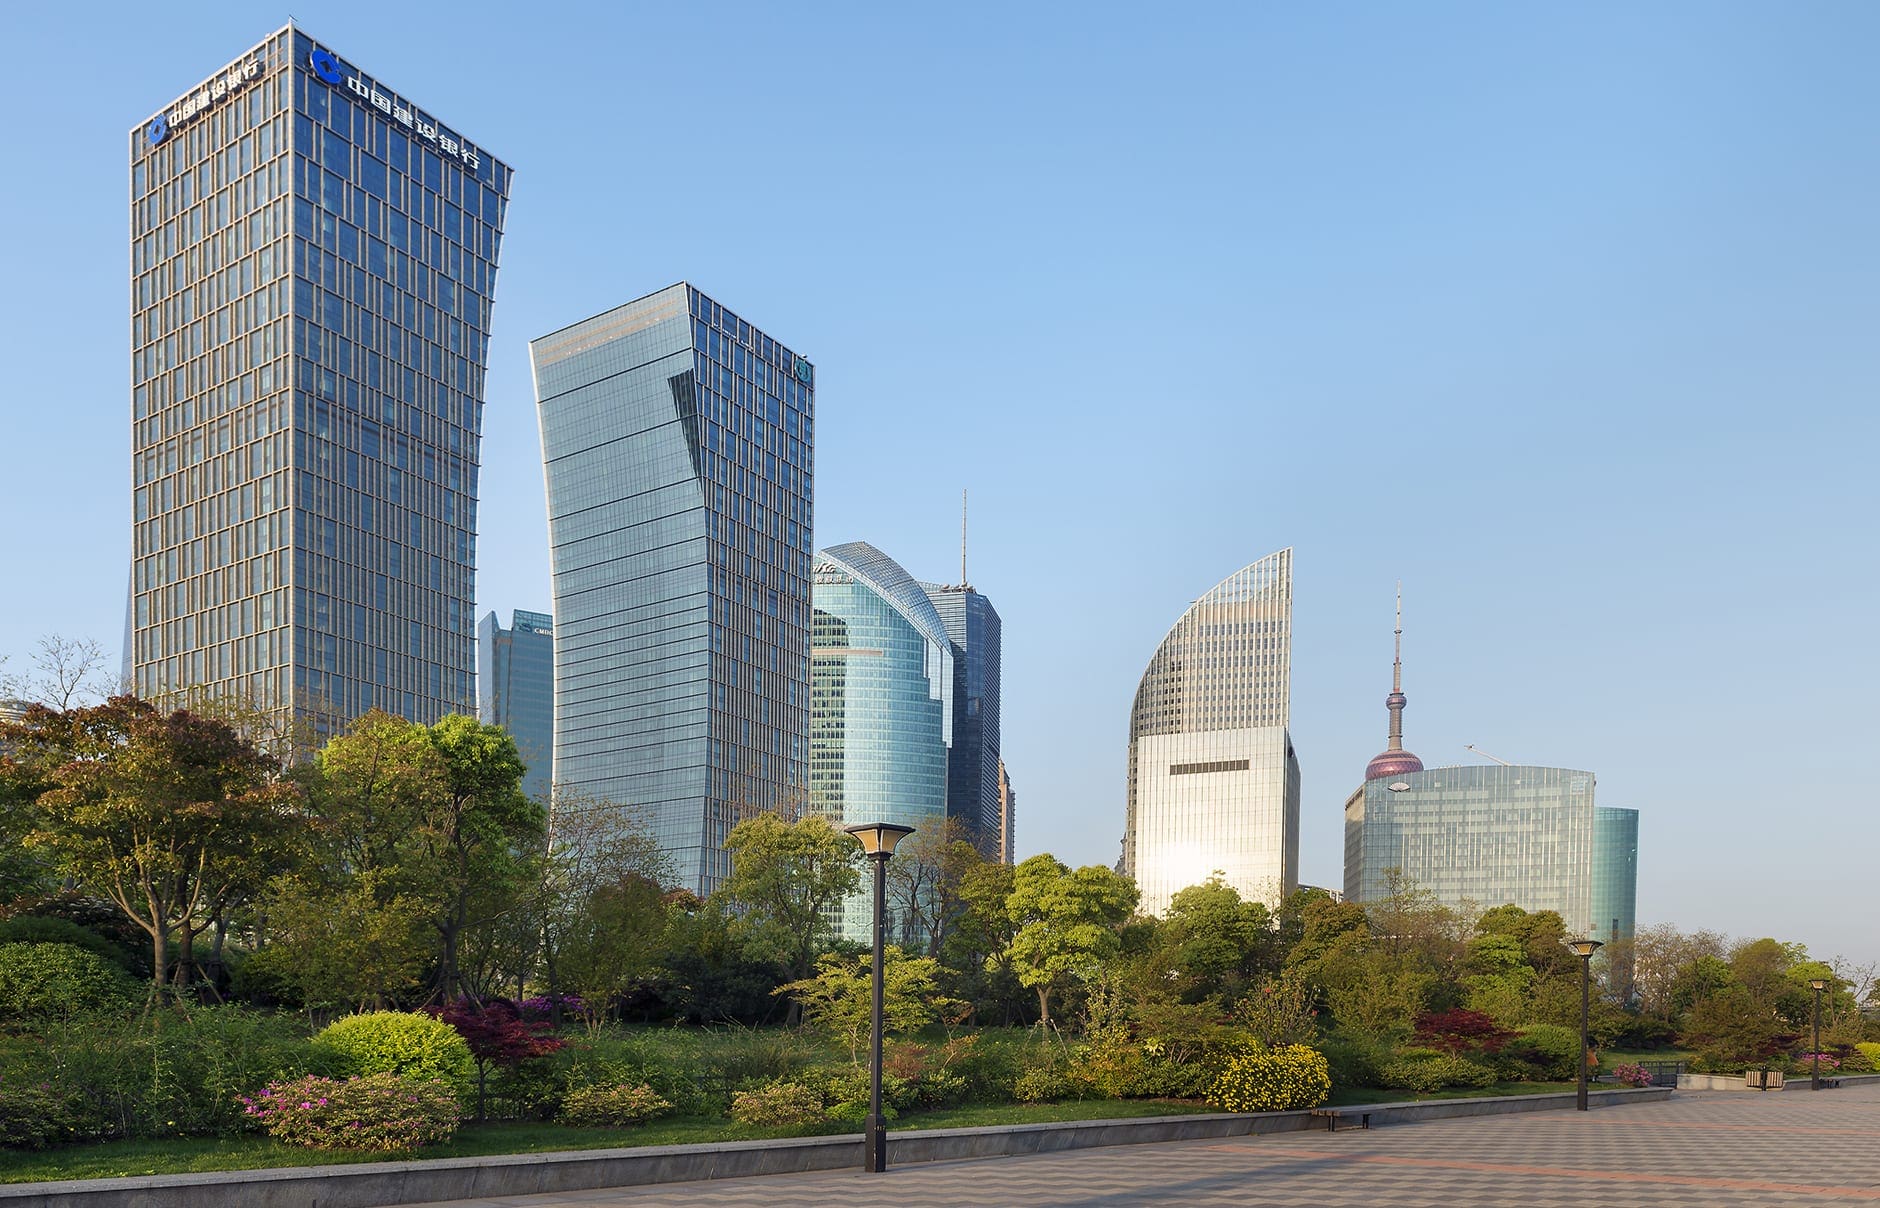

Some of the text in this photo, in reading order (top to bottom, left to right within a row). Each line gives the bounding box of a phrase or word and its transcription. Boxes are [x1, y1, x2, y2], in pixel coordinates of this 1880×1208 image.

[169, 58, 259, 128] 中国建设银行
[347, 75, 481, 170] 中国建设银行
